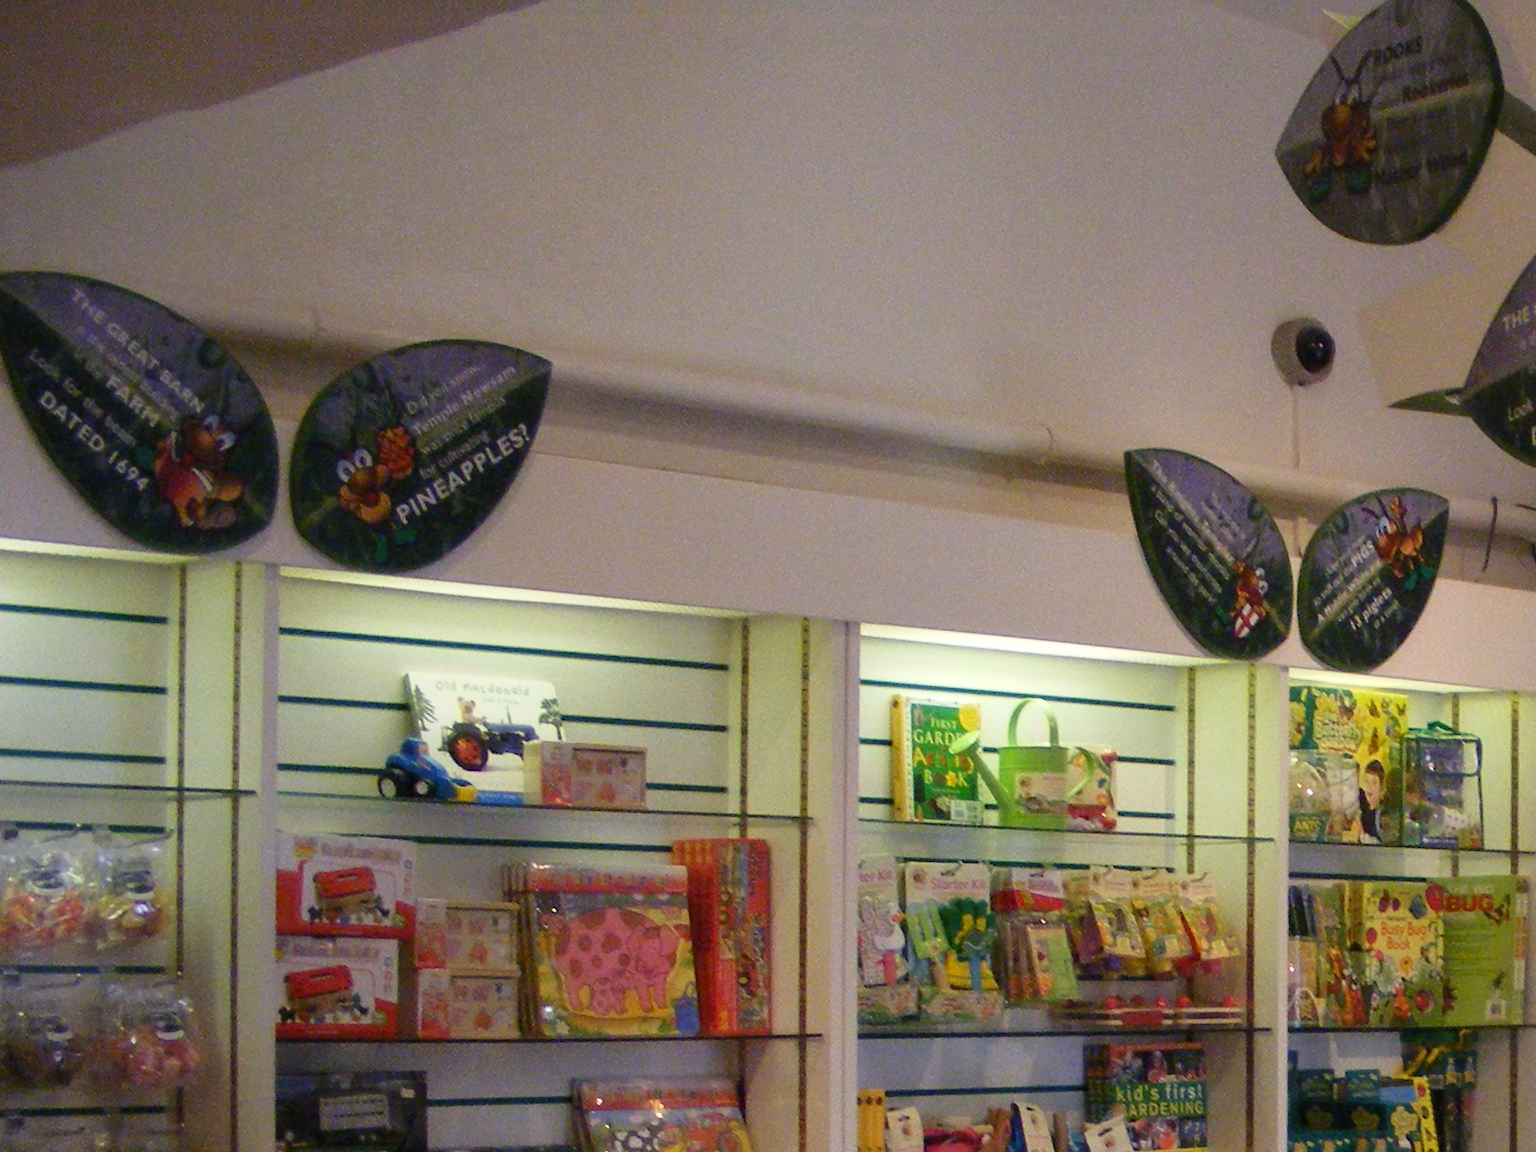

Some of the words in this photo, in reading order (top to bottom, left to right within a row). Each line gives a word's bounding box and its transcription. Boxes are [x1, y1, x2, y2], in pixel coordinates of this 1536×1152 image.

[1502, 306, 1530, 331] THE
[106, 321, 160, 368] GREAT
[159, 369, 206, 414] BARN
[106, 374, 161, 428] FARM
[1507, 398, 1534, 422] Look
[411, 402, 460, 435] Temple
[38, 389, 106, 454] DATED
[107, 450, 151, 493] 1694
[435, 680, 457, 691] Old
[931, 717, 957, 729] FIRST
[913, 728, 963, 746] GARD
[1444, 893, 1494, 913] BUG
[1115, 1083, 1160, 1102] kid's
[1165, 1082, 1203, 1100] first
[1123, 1100, 1204, 1118] ARDENING
